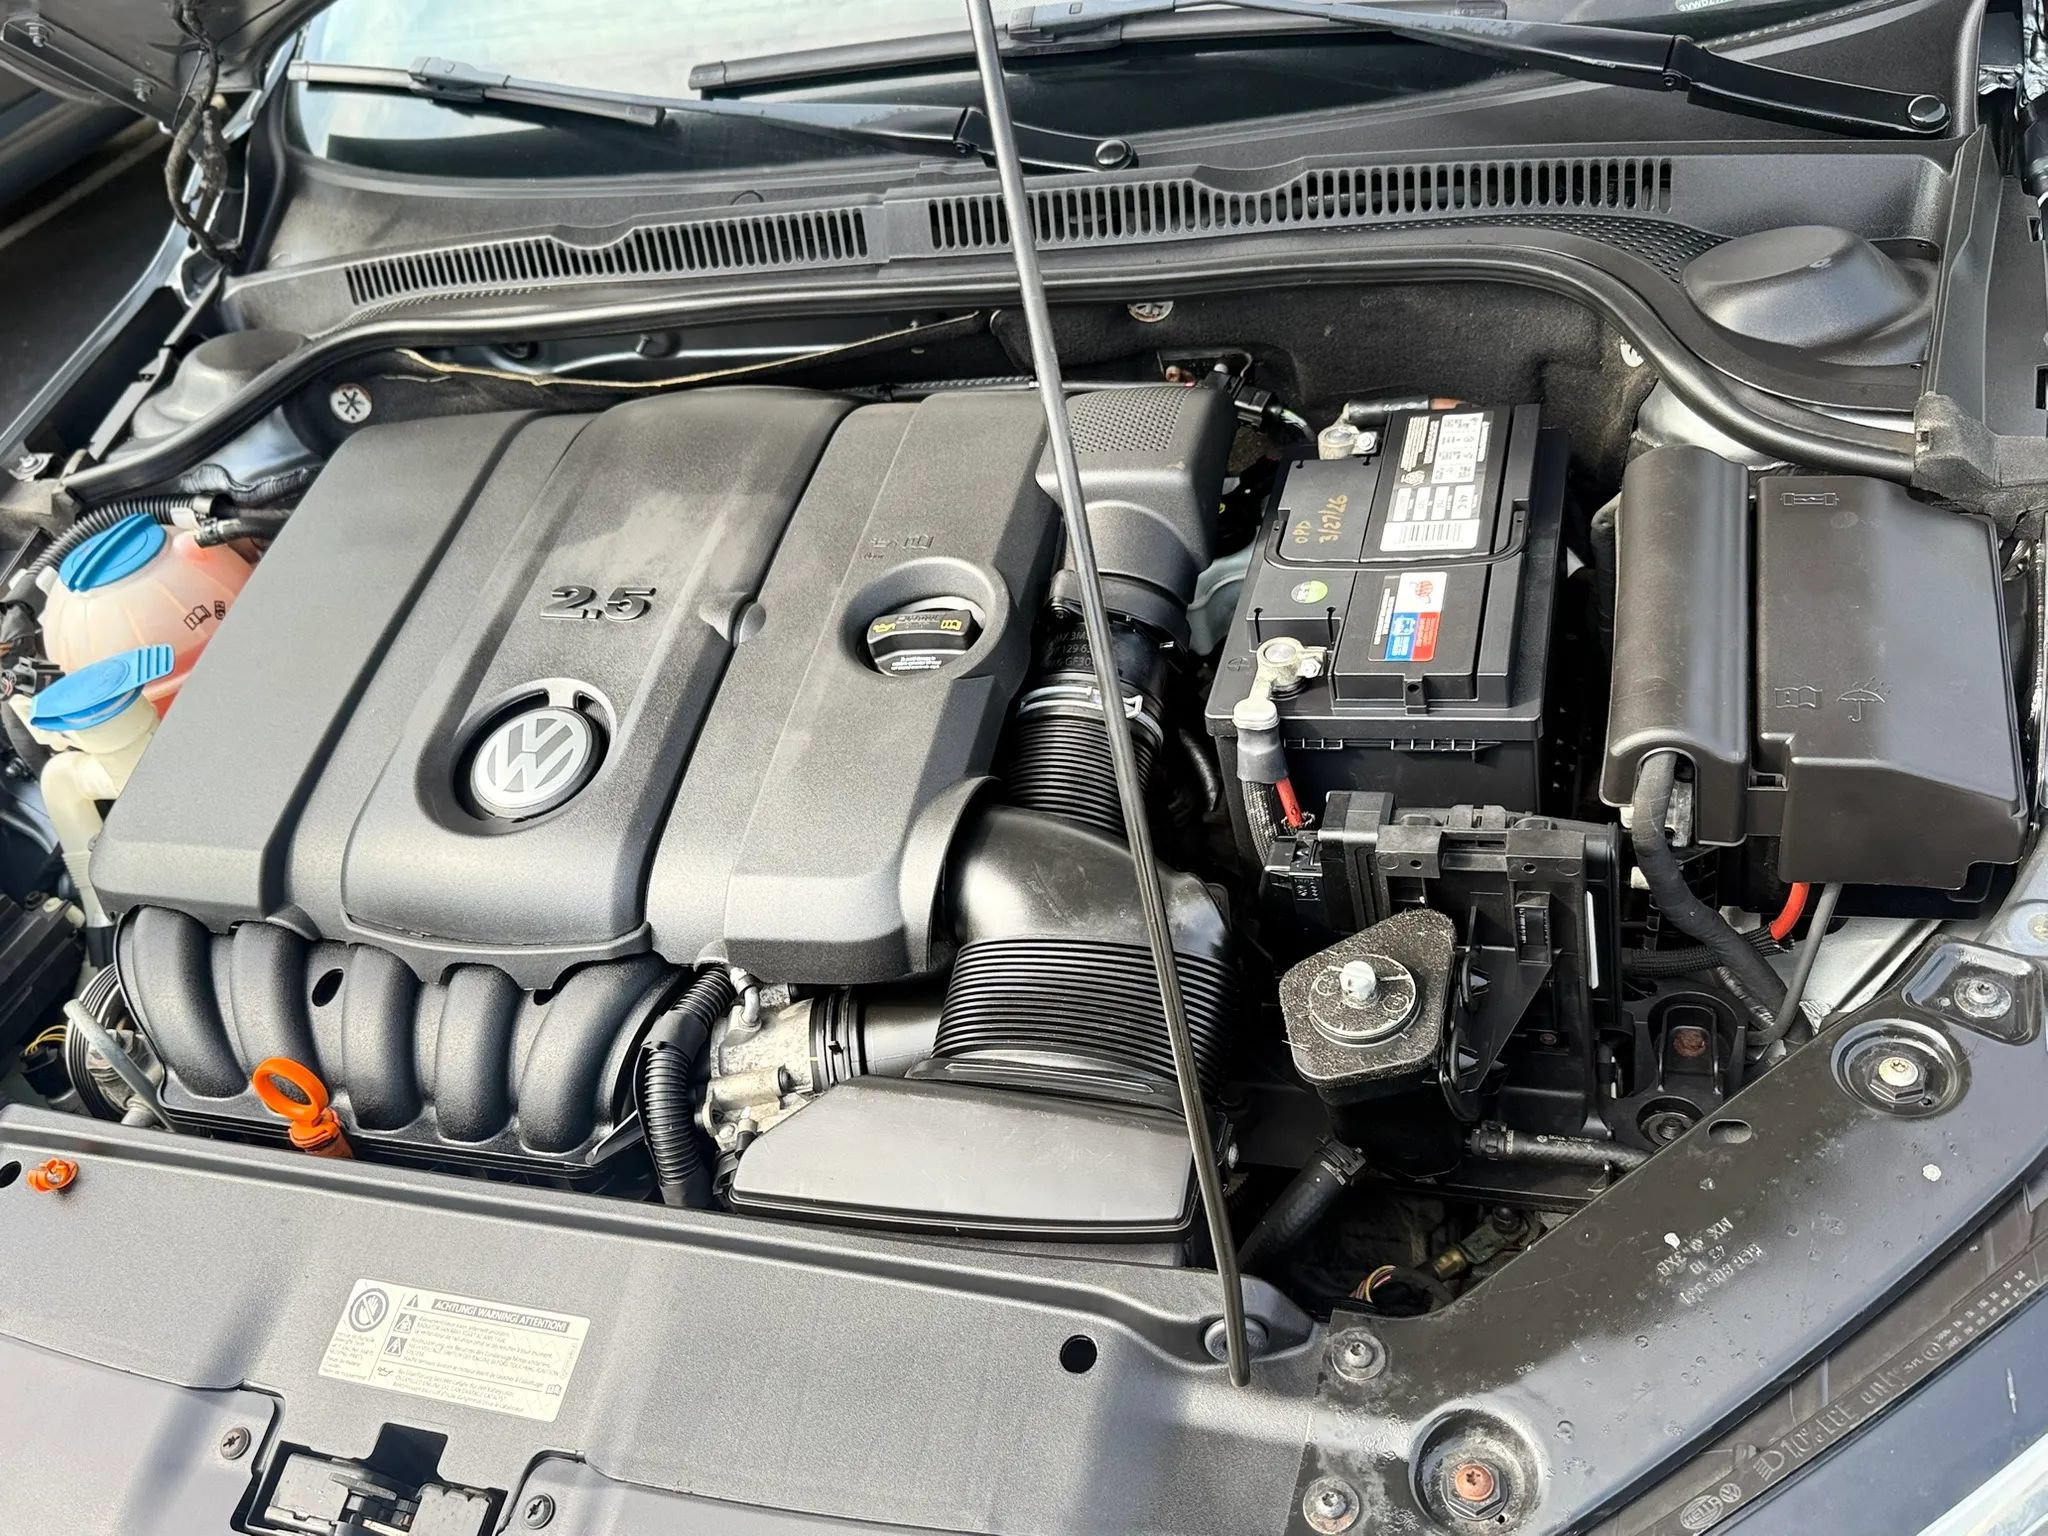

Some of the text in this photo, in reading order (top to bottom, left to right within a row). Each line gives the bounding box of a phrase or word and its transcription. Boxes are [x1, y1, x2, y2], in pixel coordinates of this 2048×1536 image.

[1317, 495, 1348, 544] 3/27/26
[539, 584, 657, 623] 2.5
[434, 1300, 567, 1333] ACHTUNG! WARNING! ATTENTION!
[1683, 1497, 1724, 1526] HELLA
